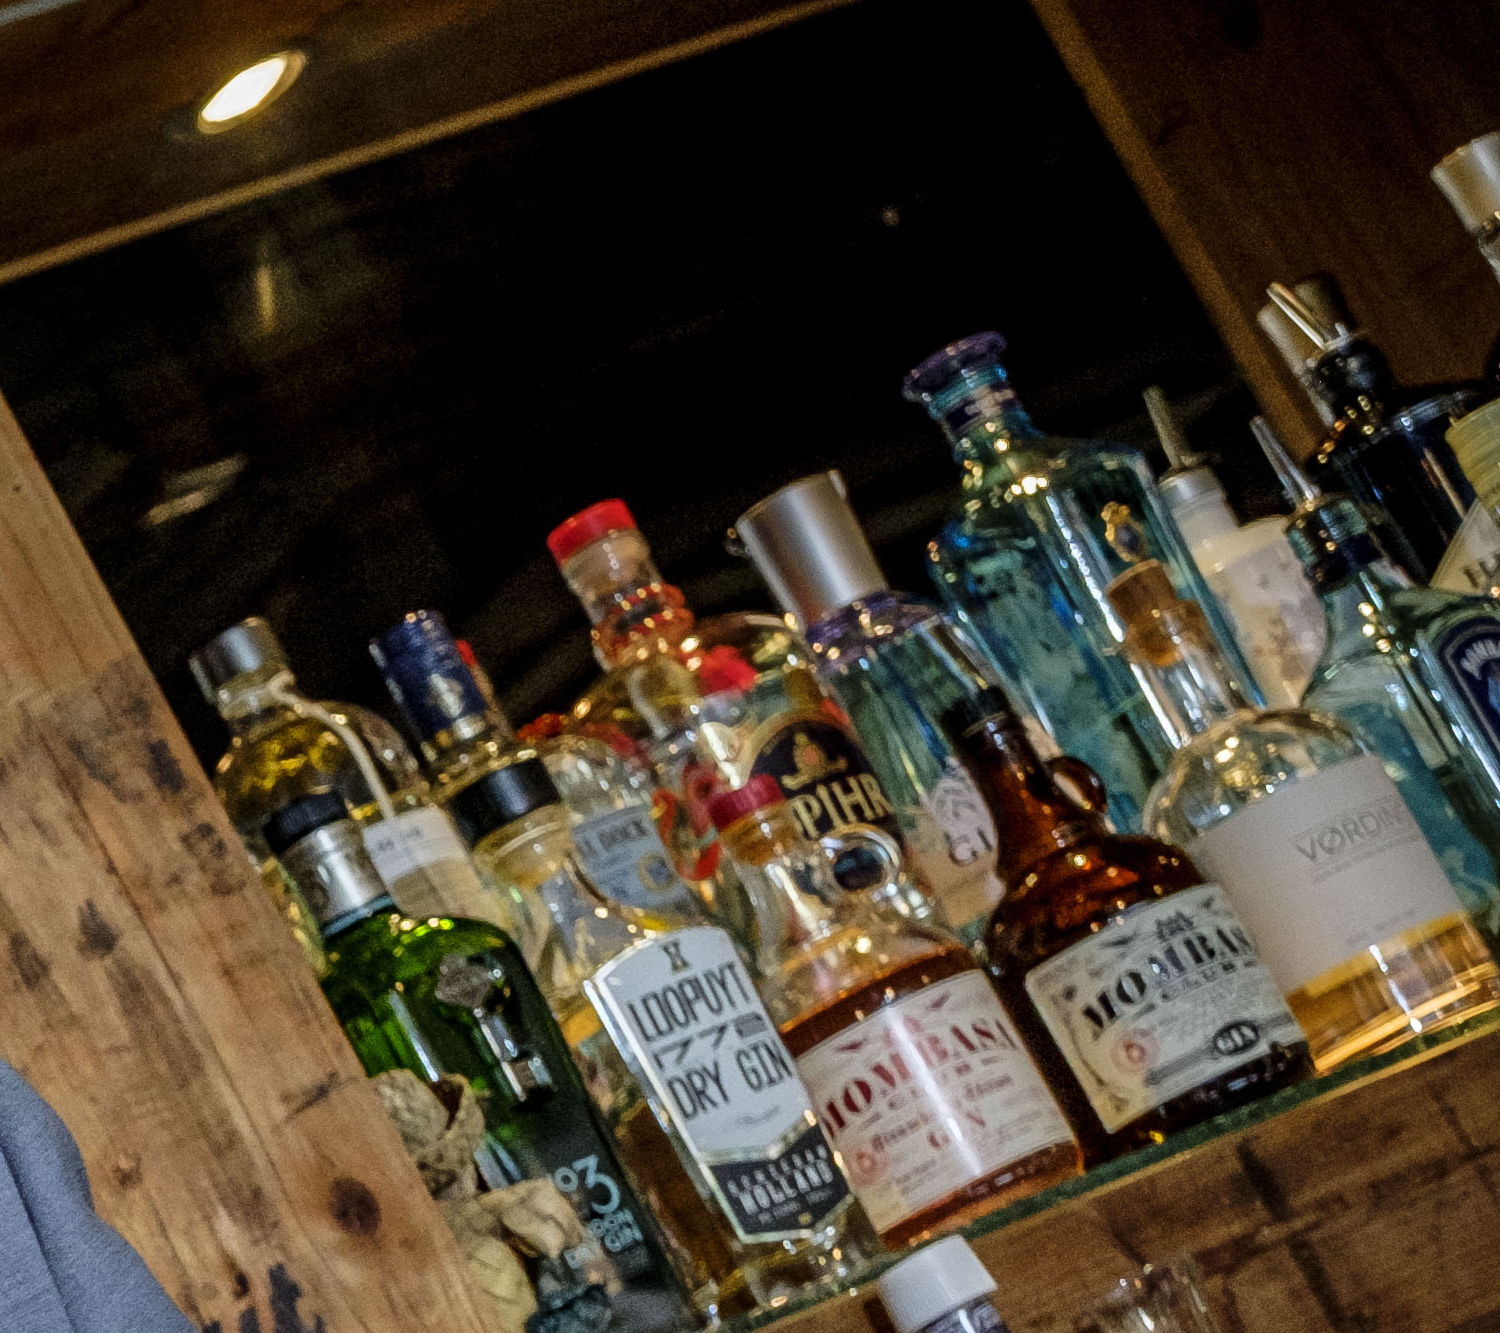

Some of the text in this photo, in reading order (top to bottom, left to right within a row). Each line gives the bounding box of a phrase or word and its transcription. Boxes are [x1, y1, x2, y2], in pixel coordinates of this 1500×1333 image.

[628, 960, 749, 1043] LOOPUYT
[668, 1039, 793, 1121] DRY GIN
